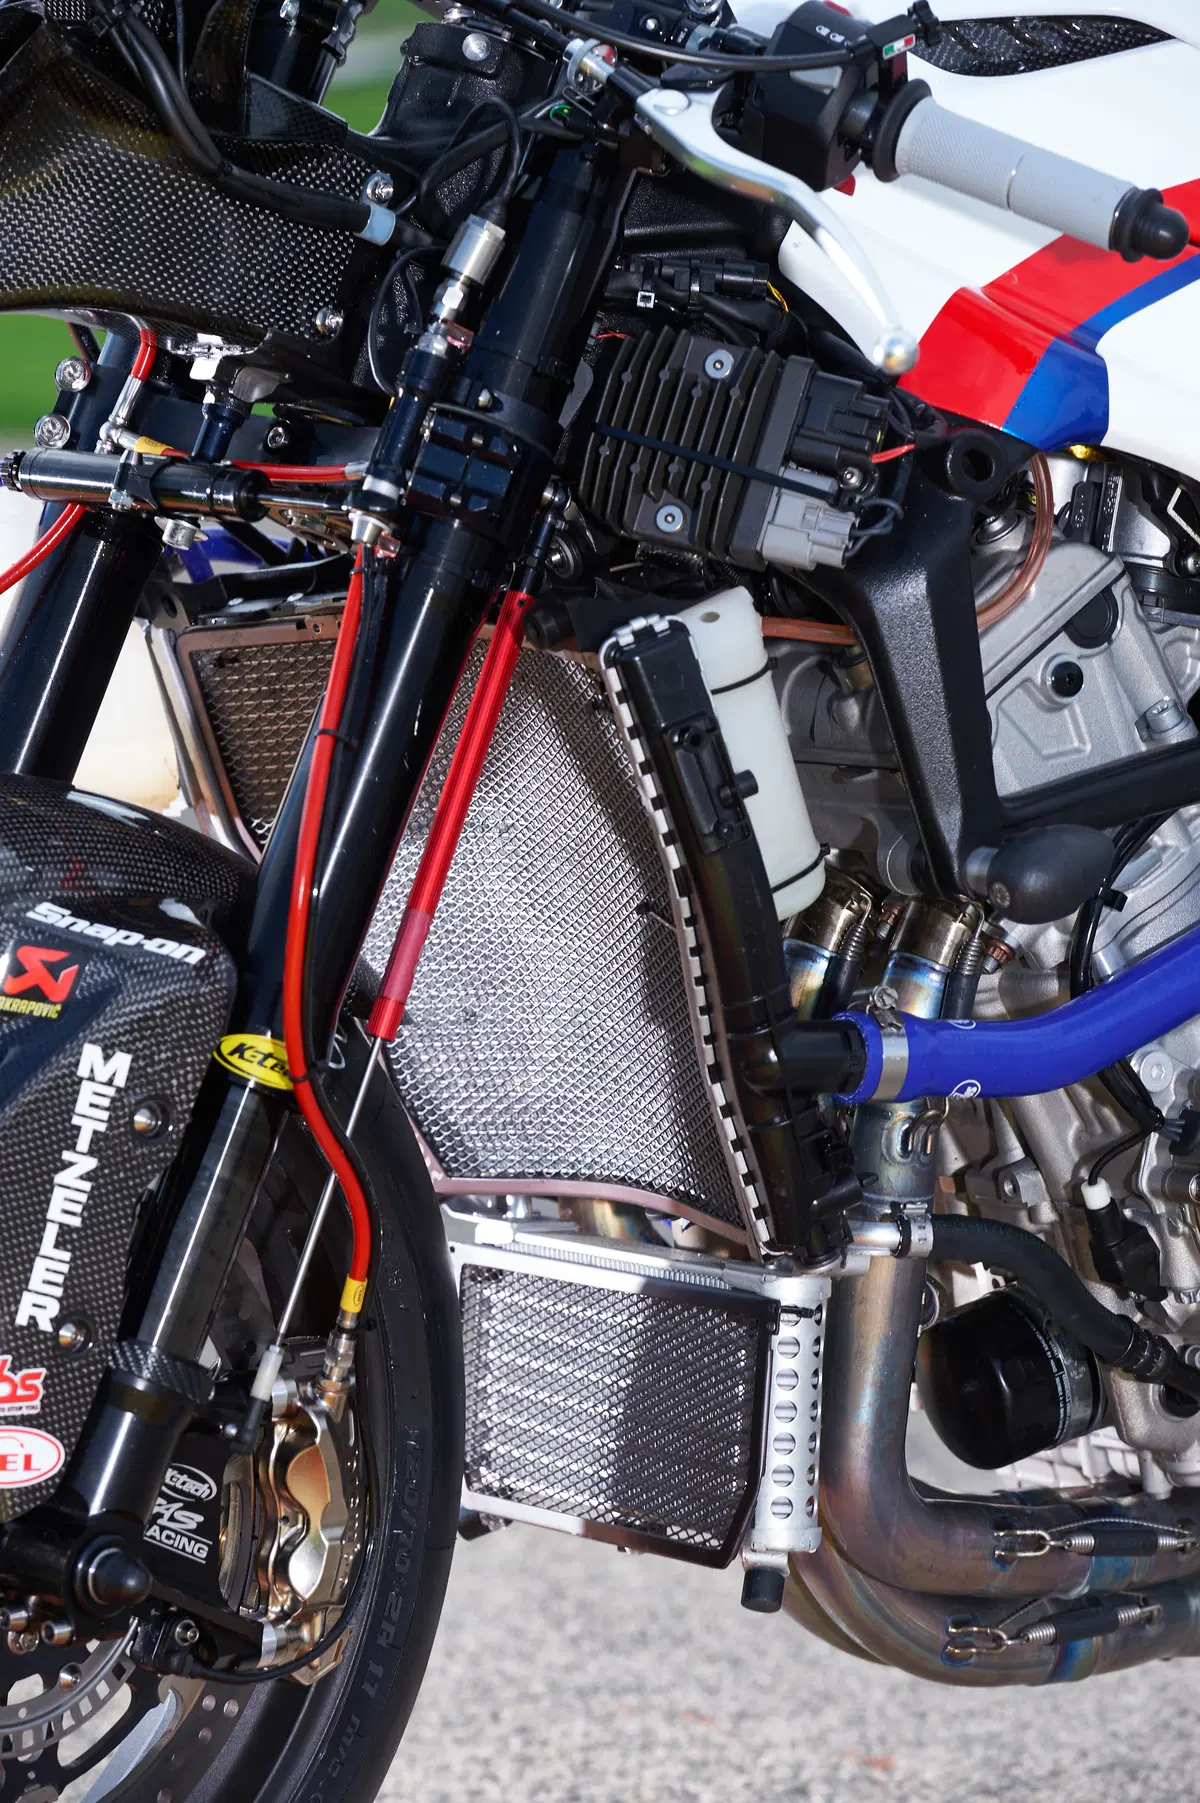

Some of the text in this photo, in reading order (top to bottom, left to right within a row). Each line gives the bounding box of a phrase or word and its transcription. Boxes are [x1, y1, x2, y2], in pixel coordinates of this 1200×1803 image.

[26, 902, 206, 965] Snap-on
[15, 1043, 132, 1332] METZELER
[145, 1524, 209, 1559] ACING
